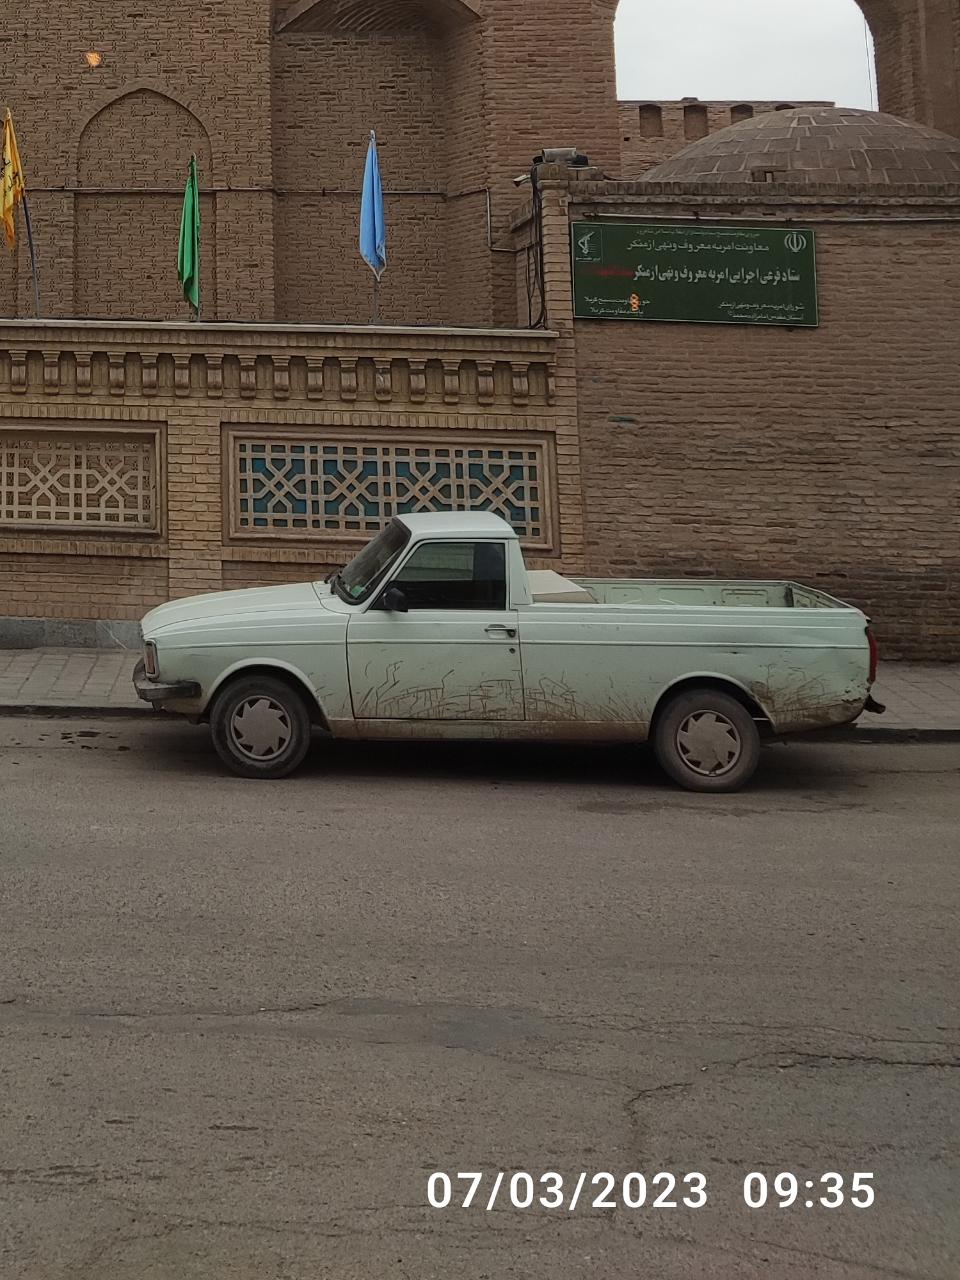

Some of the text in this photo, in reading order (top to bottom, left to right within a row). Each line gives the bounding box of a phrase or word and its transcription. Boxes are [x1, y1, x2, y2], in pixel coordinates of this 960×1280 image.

[626, 239, 648, 250] منکر
[678, 239, 711, 252] معروف
[722, 242, 734, 253] امر
[735, 242, 770, 254] معاونت
[633, 264, 651, 281] منکر
[650, 264, 658, 280] از
[658, 266, 673, 281] نهی
[680, 265, 707, 282] معروف
[715, 267, 728, 284] امر
[760, 266, 781, 285] فرعی
[782, 268, 800, 281] ستاد
